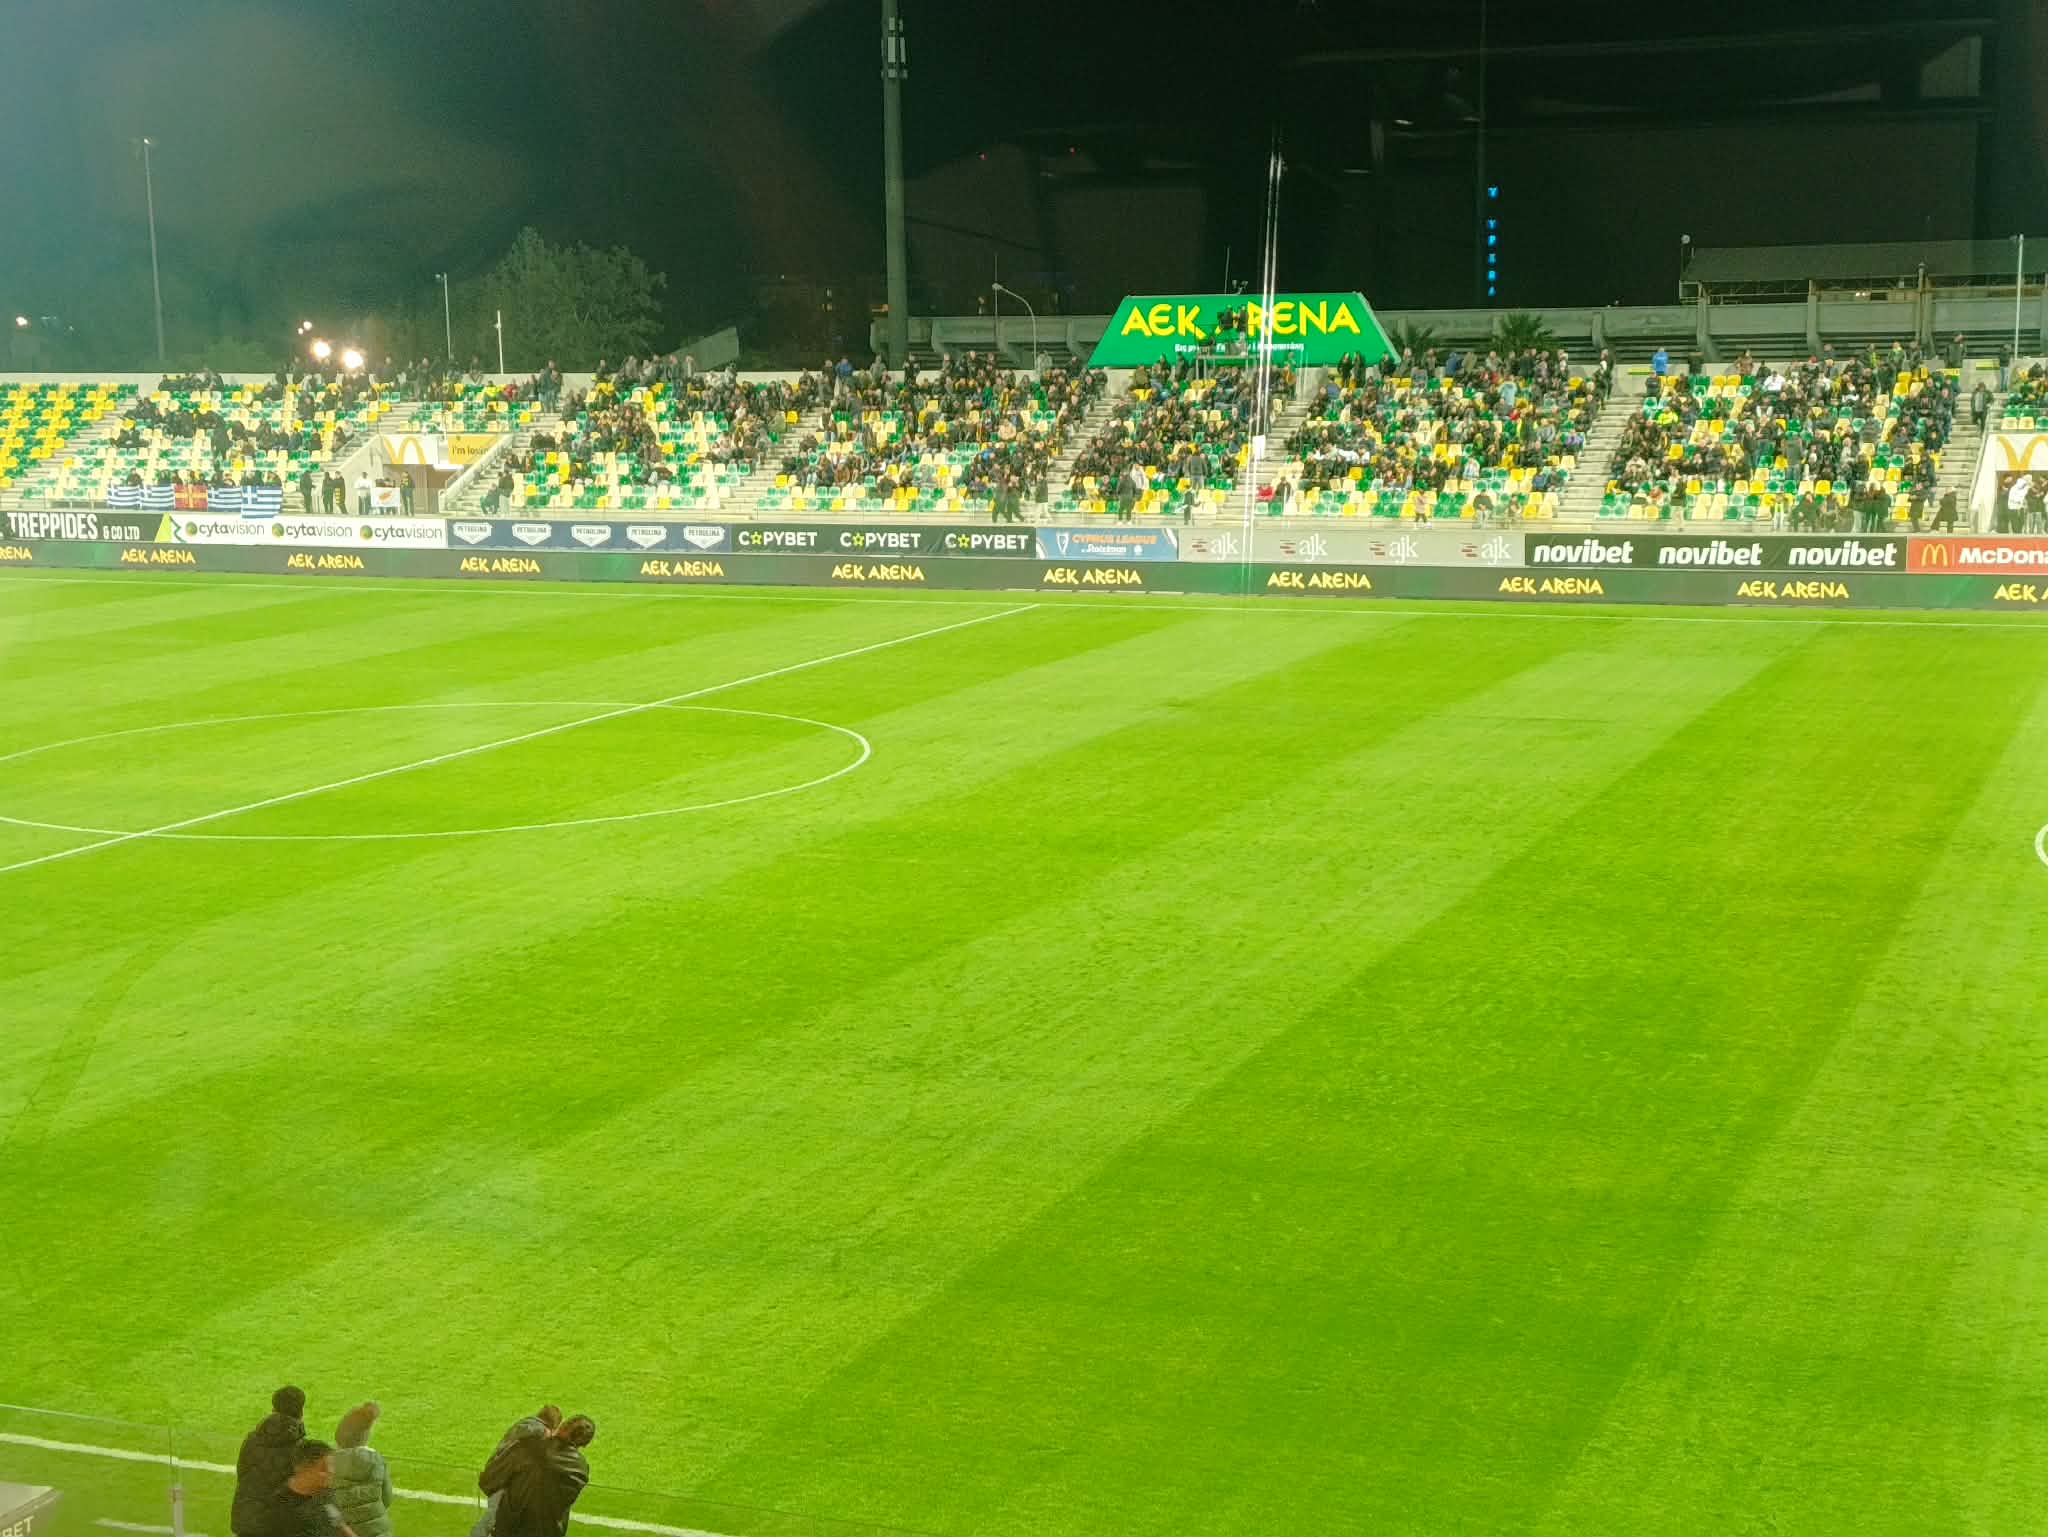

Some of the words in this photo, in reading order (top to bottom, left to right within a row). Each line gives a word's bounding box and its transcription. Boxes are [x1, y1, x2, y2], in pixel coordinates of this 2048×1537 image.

[1120, 304, 1206, 340] AEK
[1215, 301, 1361, 336] RENA
[7, 511, 98, 539] TREPPIDES
[124, 526, 140, 540] LTD
[199, 521, 265, 538] cytavision
[286, 522, 352, 539] cytavision
[374, 524, 442, 542] cytavision
[1210, 532, 1239, 561] ajk
[1299, 533, 1328, 562] ajk
[1389, 535, 1419, 564] ajk
[1481, 536, 1511, 565] ajk
[1534, 539, 1634, 564] novibet
[1658, 541, 1763, 566] novibet
[1788, 541, 1898, 567] novibet
[121, 549, 149, 564] AEK
[150, 549, 196, 565] ARENA
[287, 553, 315, 569] AEK
[317, 553, 364, 569] ARENA
[460, 557, 490, 573] AEK
[492, 558, 540, 574] ARENA
[640, 560, 671, 576] AEK
[673, 560, 724, 577] ARENA
[832, 564, 865, 581] AEK
[868, 564, 924, 581] ARENA
[1043, 568, 1079, 585] AEK
[1082, 568, 1142, 585] ARENA
[1267, 572, 1305, 590] AEK
[1308, 572, 1372, 590] ARENA
[1499, 577, 1536, 595] AEK
[1539, 577, 1604, 595] ARENA
[1737, 581, 1777, 599] AEK
[1781, 580, 1849, 599] ARENA
[1994, 583, 2038, 603] AEK
